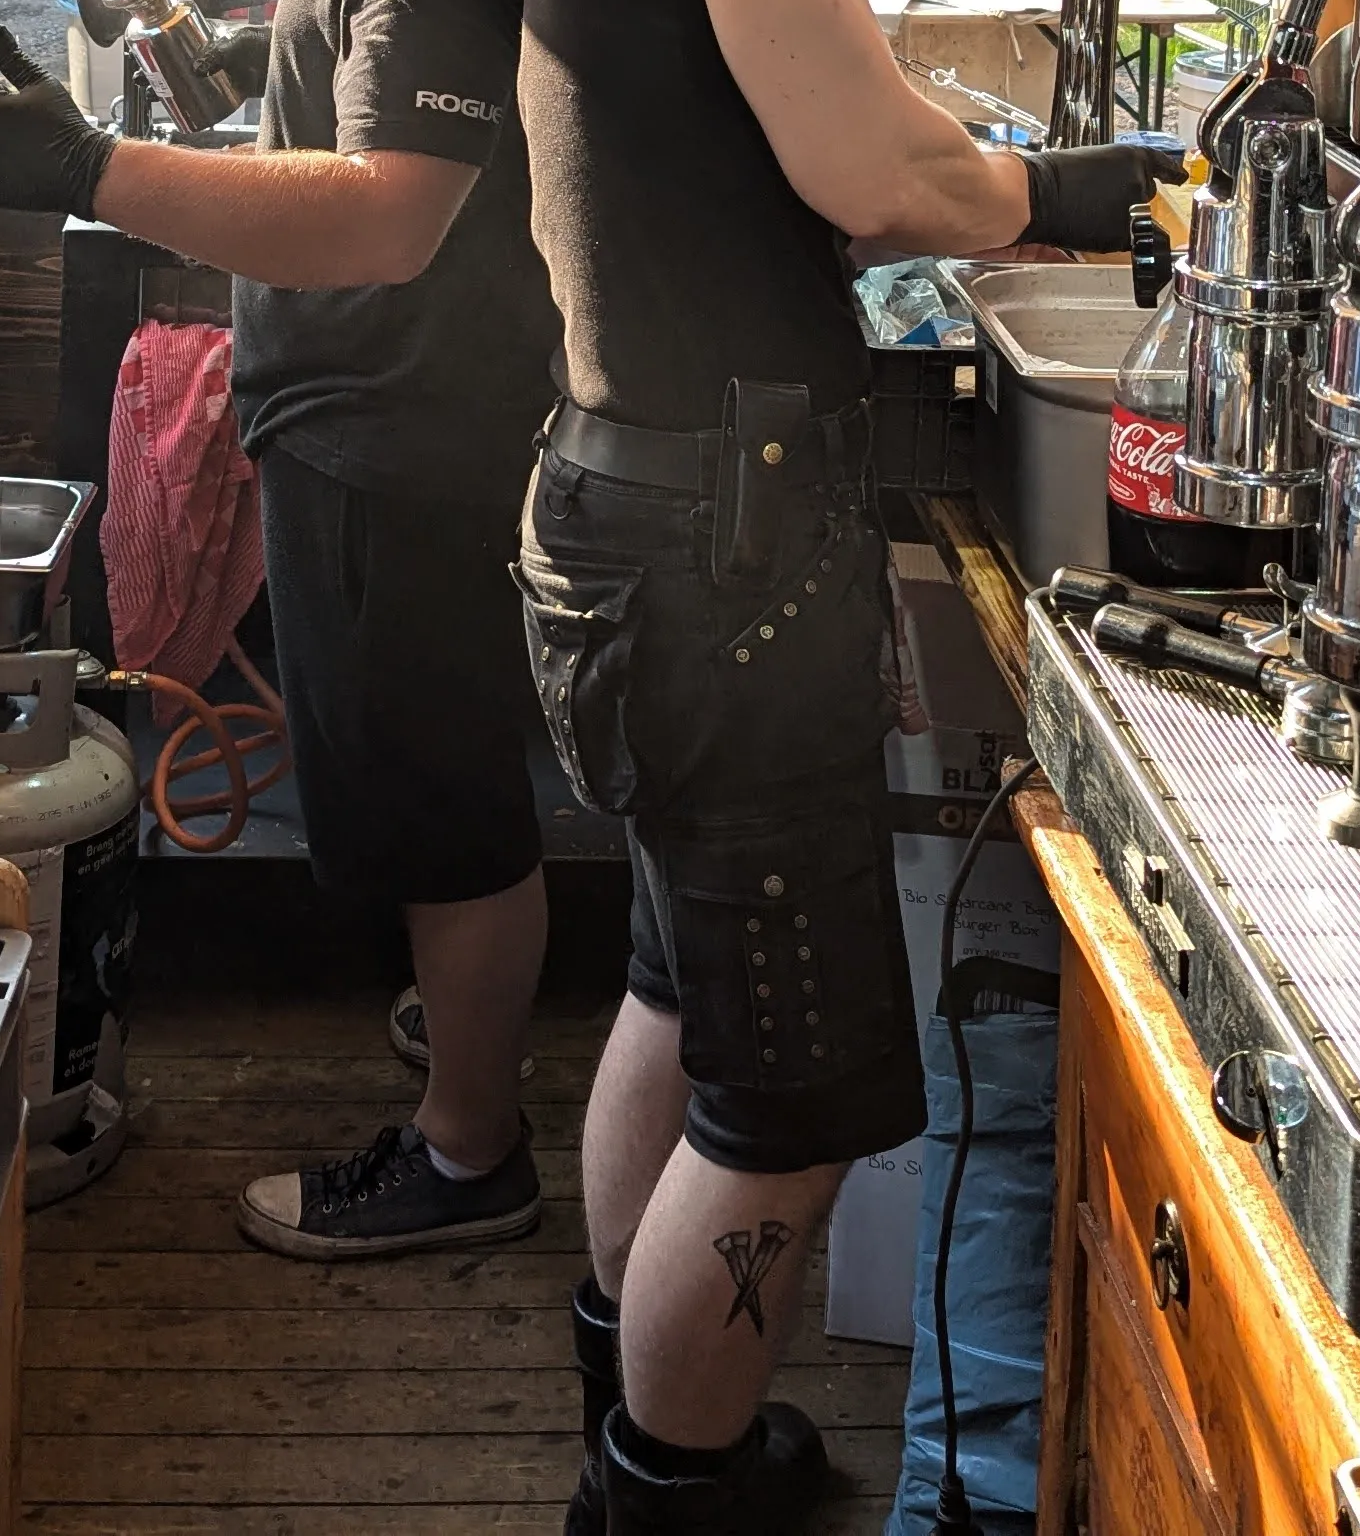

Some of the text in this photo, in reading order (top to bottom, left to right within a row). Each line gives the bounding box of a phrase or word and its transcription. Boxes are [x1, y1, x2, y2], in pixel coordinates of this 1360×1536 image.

[414, 89, 504, 125] ROGUE
[902, 887, 928, 905] Bio
[934, 892, 1015, 917] Sgarcane
[1008, 920, 1041, 937] Box
[868, 1154, 896, 1172] Bio
